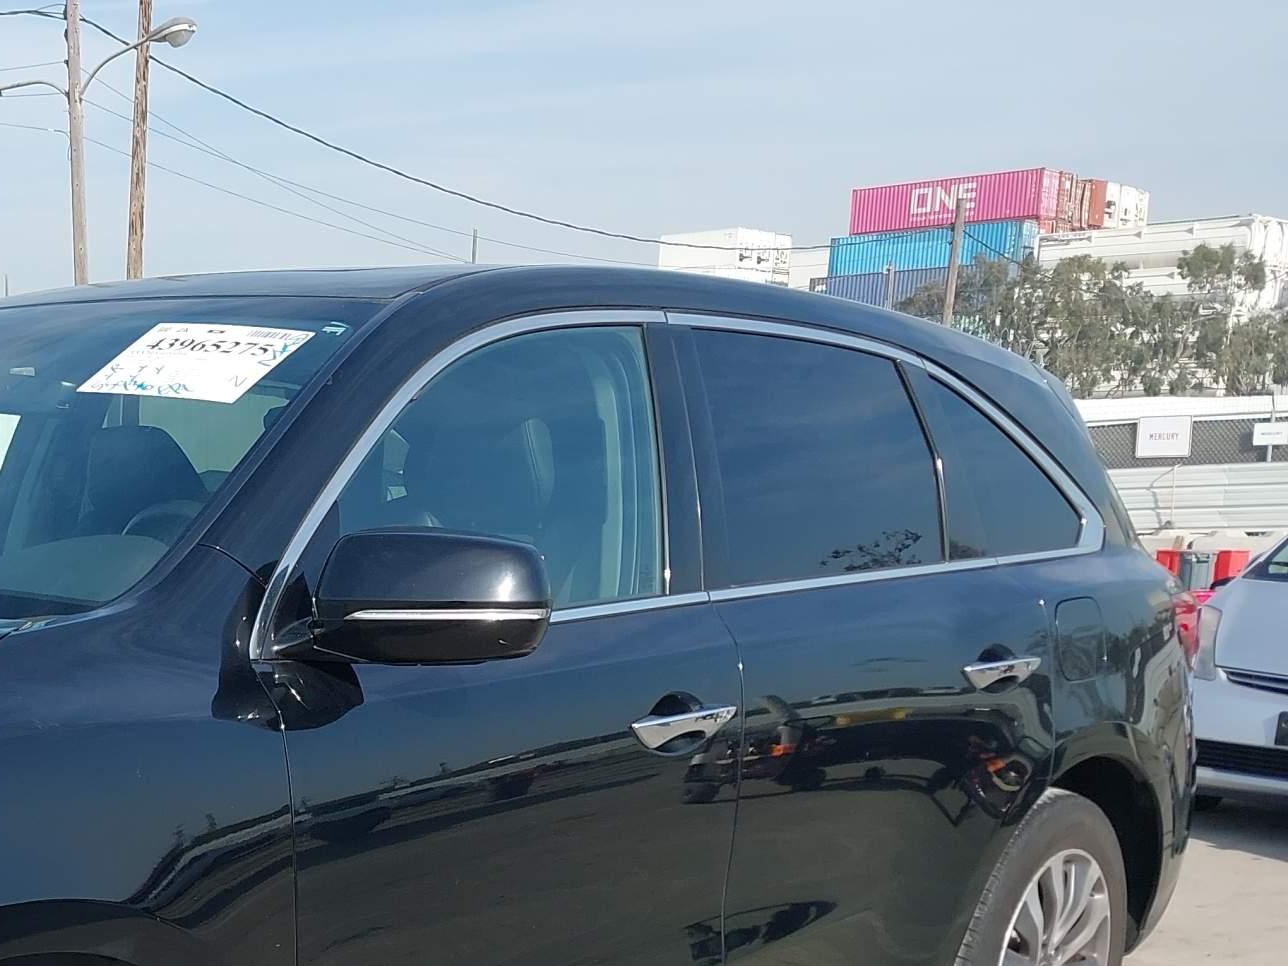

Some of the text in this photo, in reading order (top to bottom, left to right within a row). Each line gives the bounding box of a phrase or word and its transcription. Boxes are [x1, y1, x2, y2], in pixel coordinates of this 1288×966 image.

[910, 182, 977, 215] ONE
[146, 337, 274, 356] 43965275
[1148, 432, 1180, 441] MERCURY
